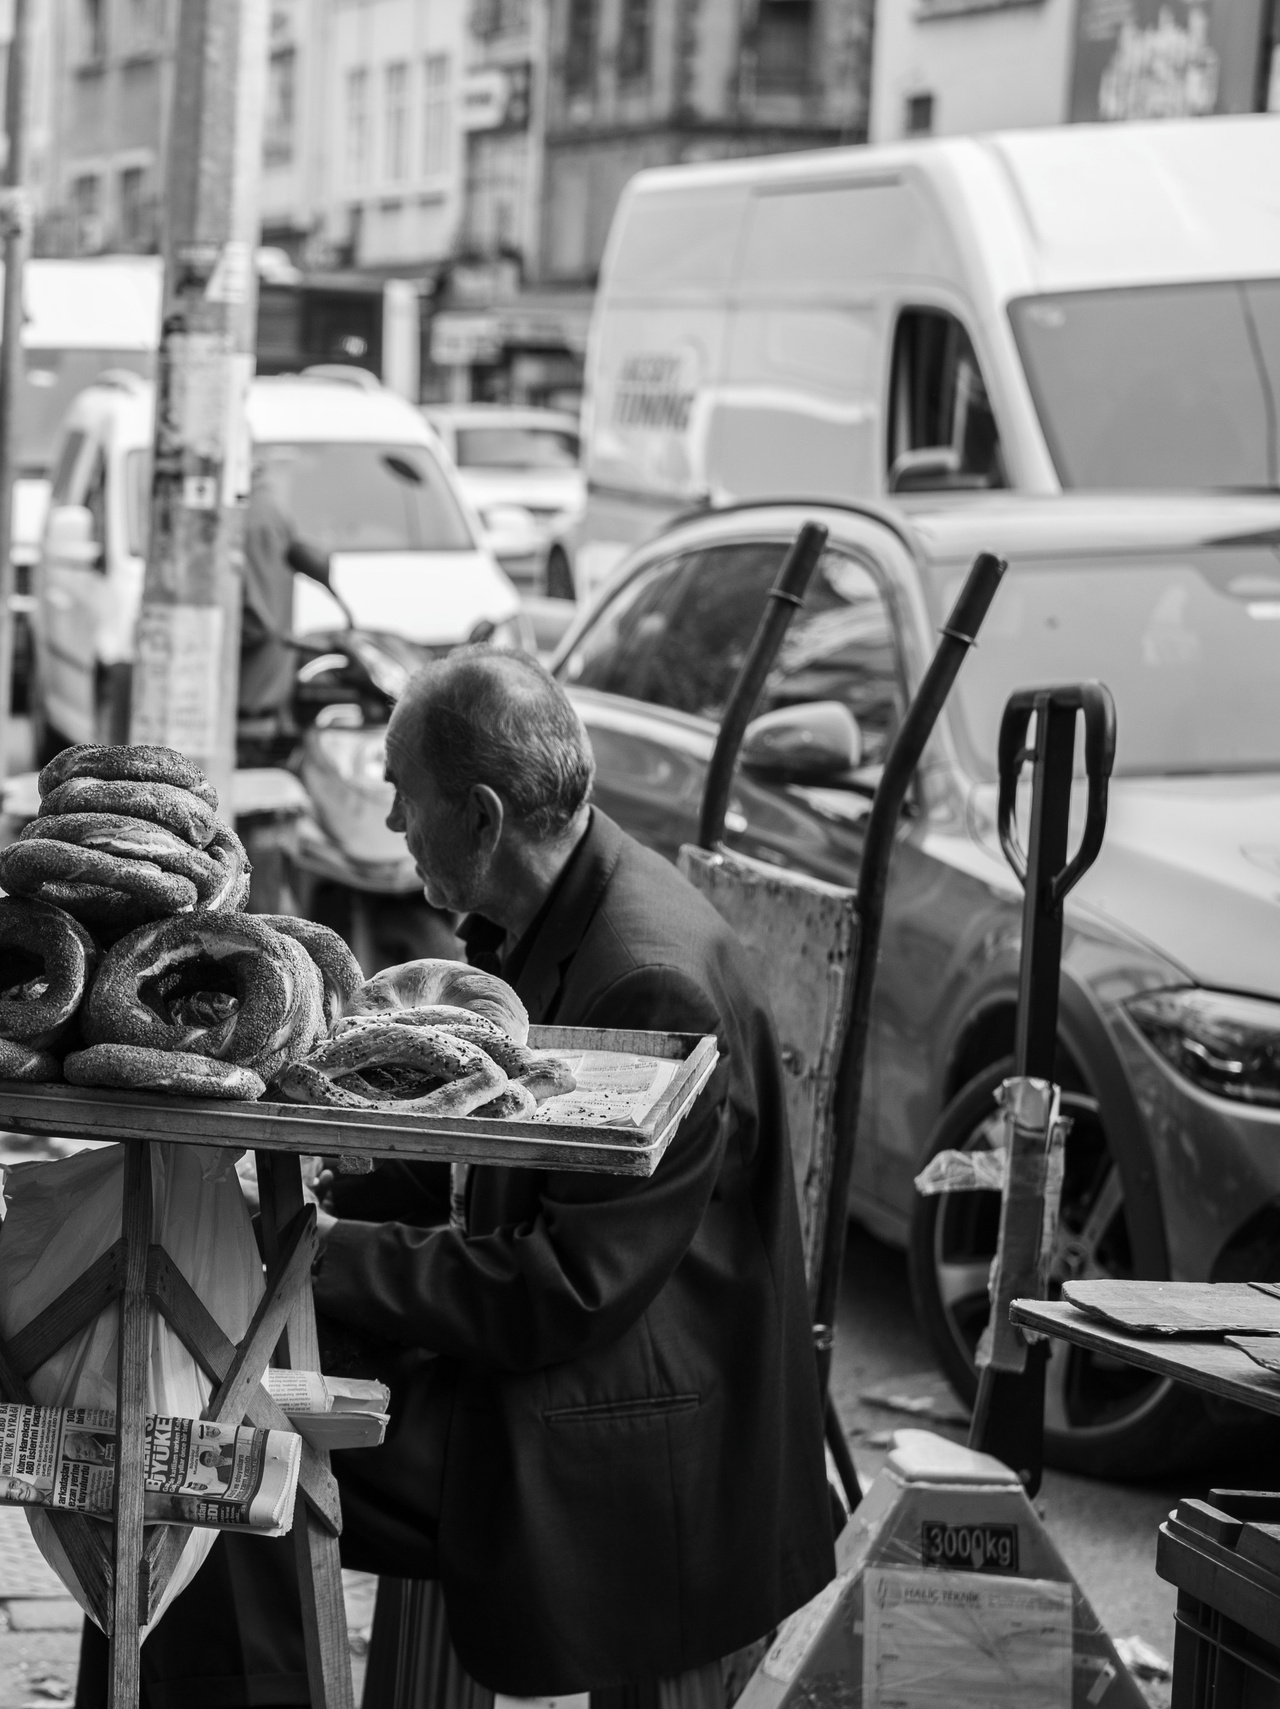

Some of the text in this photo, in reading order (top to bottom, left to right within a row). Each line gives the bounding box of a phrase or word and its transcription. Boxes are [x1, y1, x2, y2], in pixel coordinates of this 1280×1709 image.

[25, 1461, 34, 1475] ABD
[68, 1464, 80, 1507] ezan yerine
[929, 1527, 1012, 1566] 3000kg
